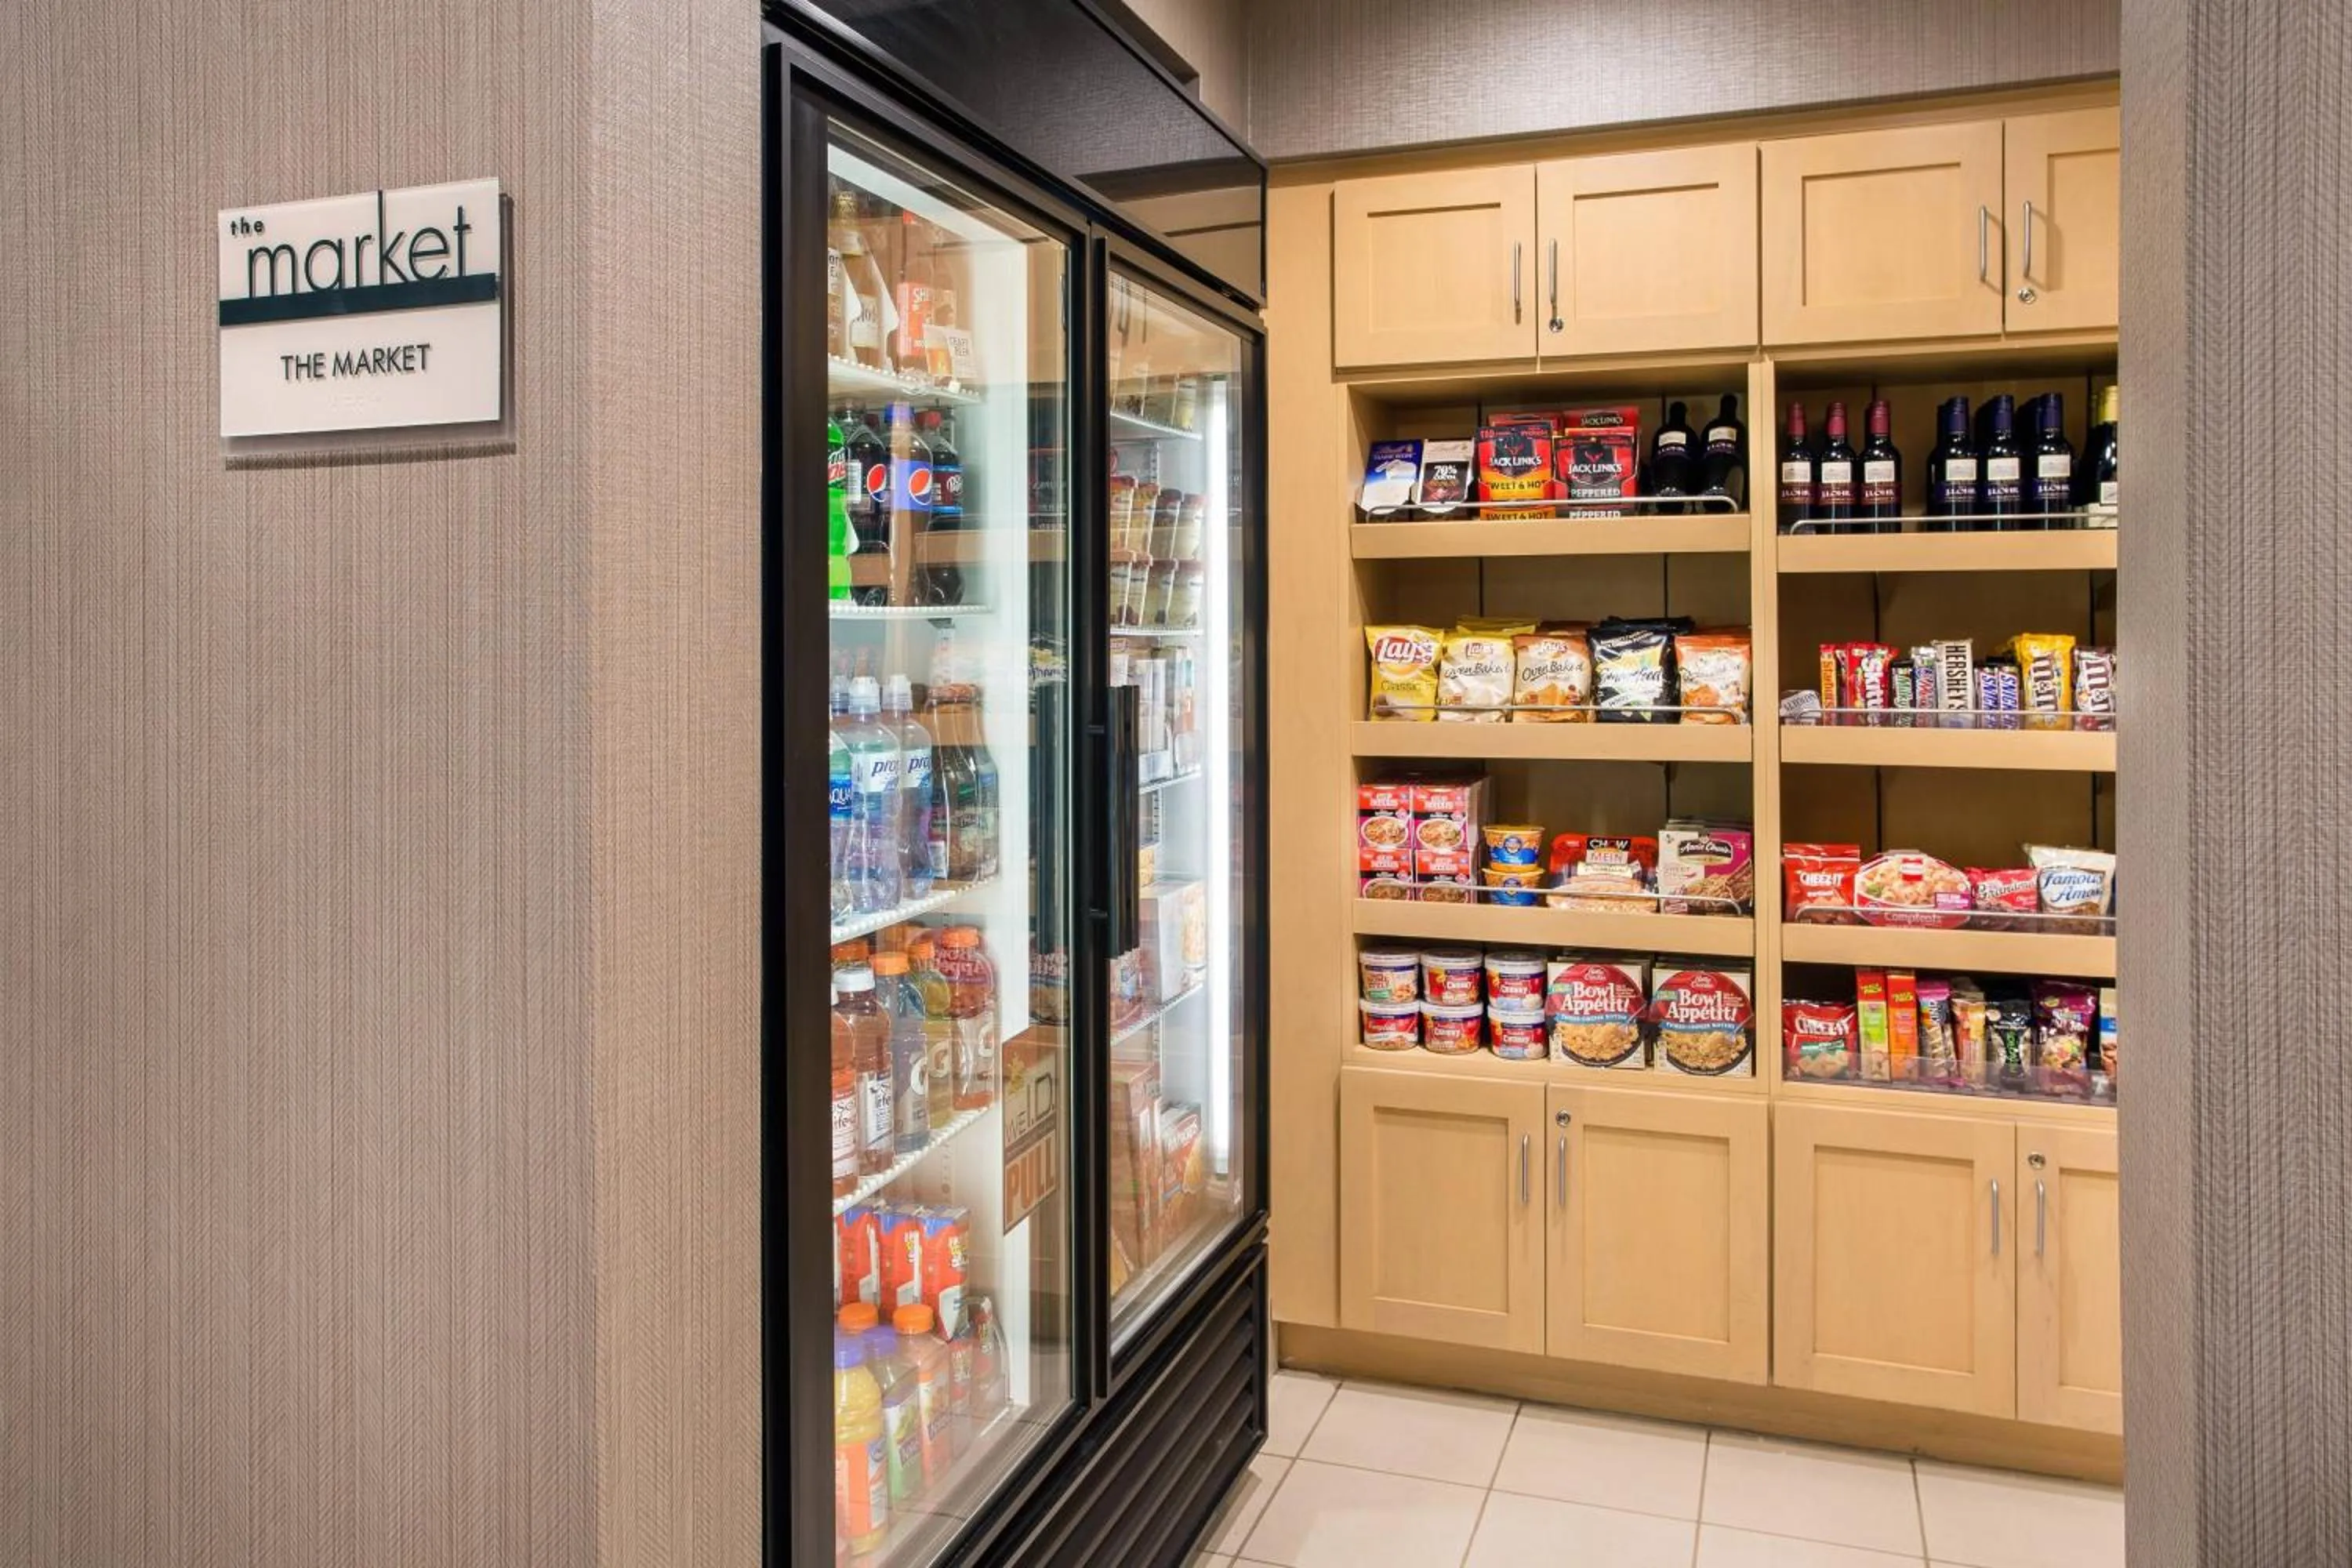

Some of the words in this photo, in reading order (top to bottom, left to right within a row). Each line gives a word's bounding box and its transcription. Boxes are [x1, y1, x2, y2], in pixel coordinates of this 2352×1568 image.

[230, 216, 265, 237] the
[248, 190, 472, 299] market
[280, 351, 325, 380] THE
[332, 343, 431, 377] MARKET
[1491, 457, 1513, 467] JACK
[1513, 456, 1543, 466] LINK'S
[1568, 463, 1592, 474] JACK
[1592, 463, 1622, 474] LINK'S
[1489, 480, 1519, 491] WEET
[1570, 488, 1621, 498] PEPPERED
[1569, 510, 1621, 519] PEPPERED
[1945, 645, 1968, 710] HERSHEY'S
[1590, 852, 1624, 862] MEIN
[2043, 870, 2103, 887] Famous
[1573, 981, 1614, 998] Bowl
[1678, 989, 1722, 1007] Bowl
[1006, 1110, 1026, 1144] WE
[1005, 1135, 1055, 1228] PULL
